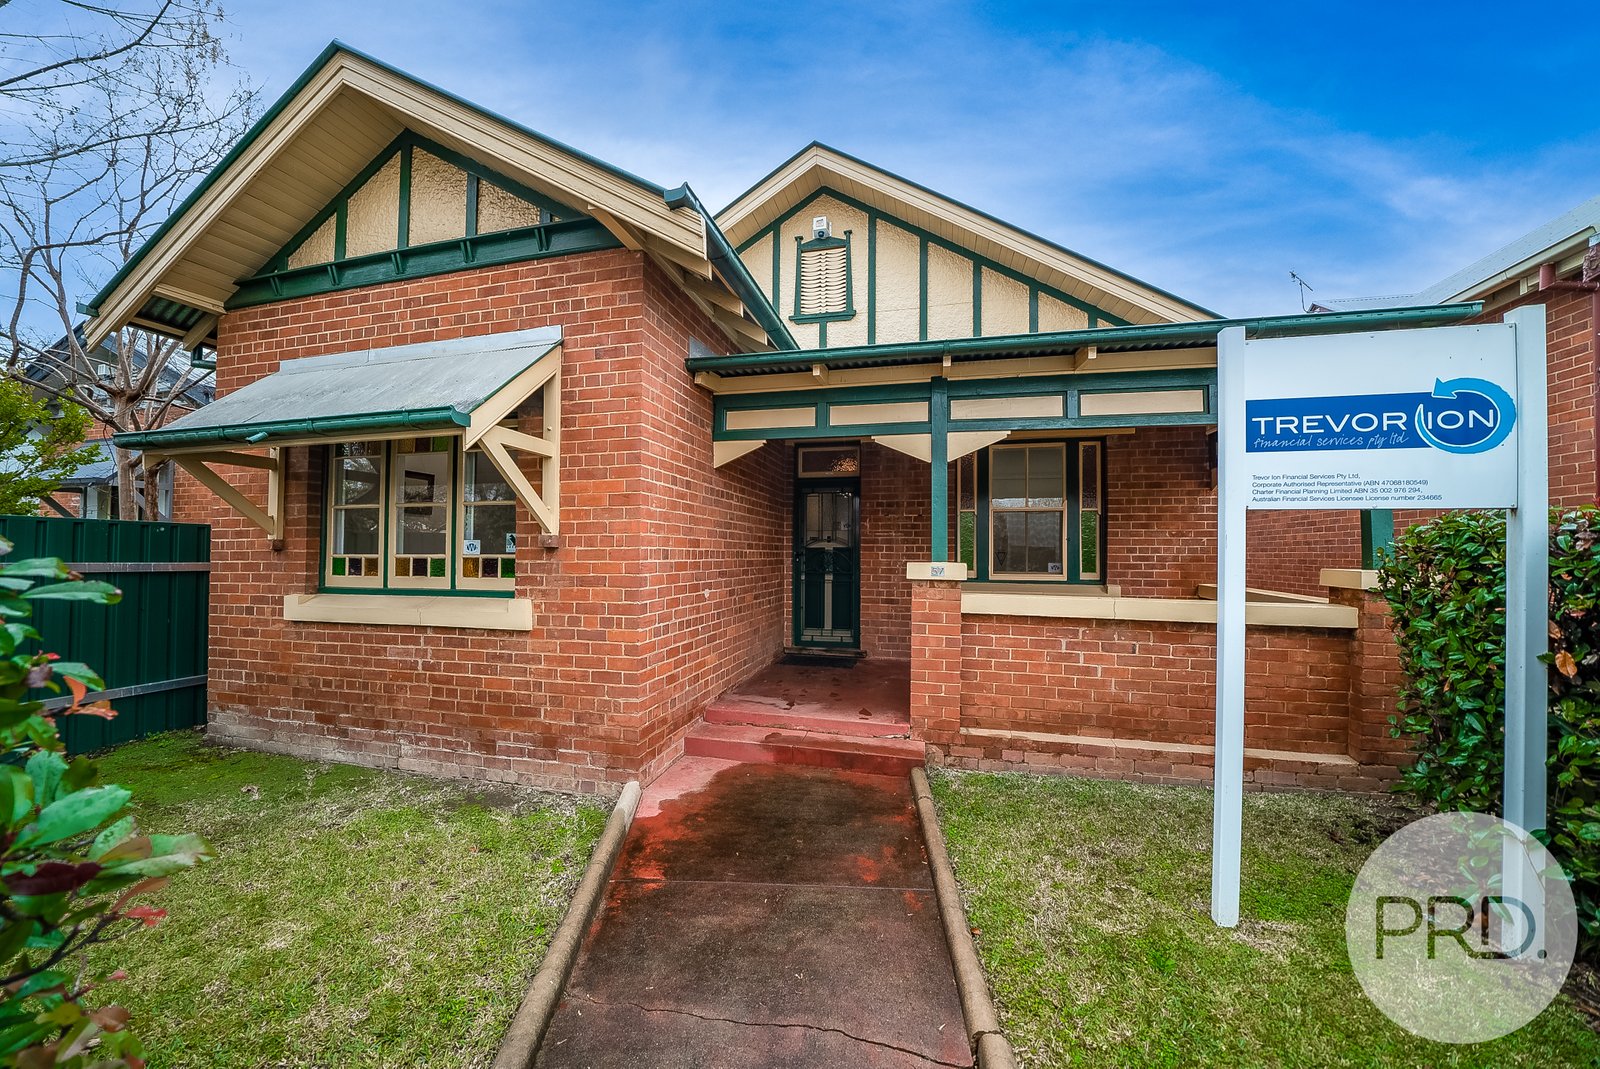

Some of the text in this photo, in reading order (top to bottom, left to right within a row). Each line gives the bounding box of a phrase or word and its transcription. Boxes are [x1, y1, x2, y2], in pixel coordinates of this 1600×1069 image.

[1252, 409, 1494, 435] TREVOR ION
[1253, 432, 1409, 450] financial services pty ltd
[1336, 473, 1347, 481] Pty
